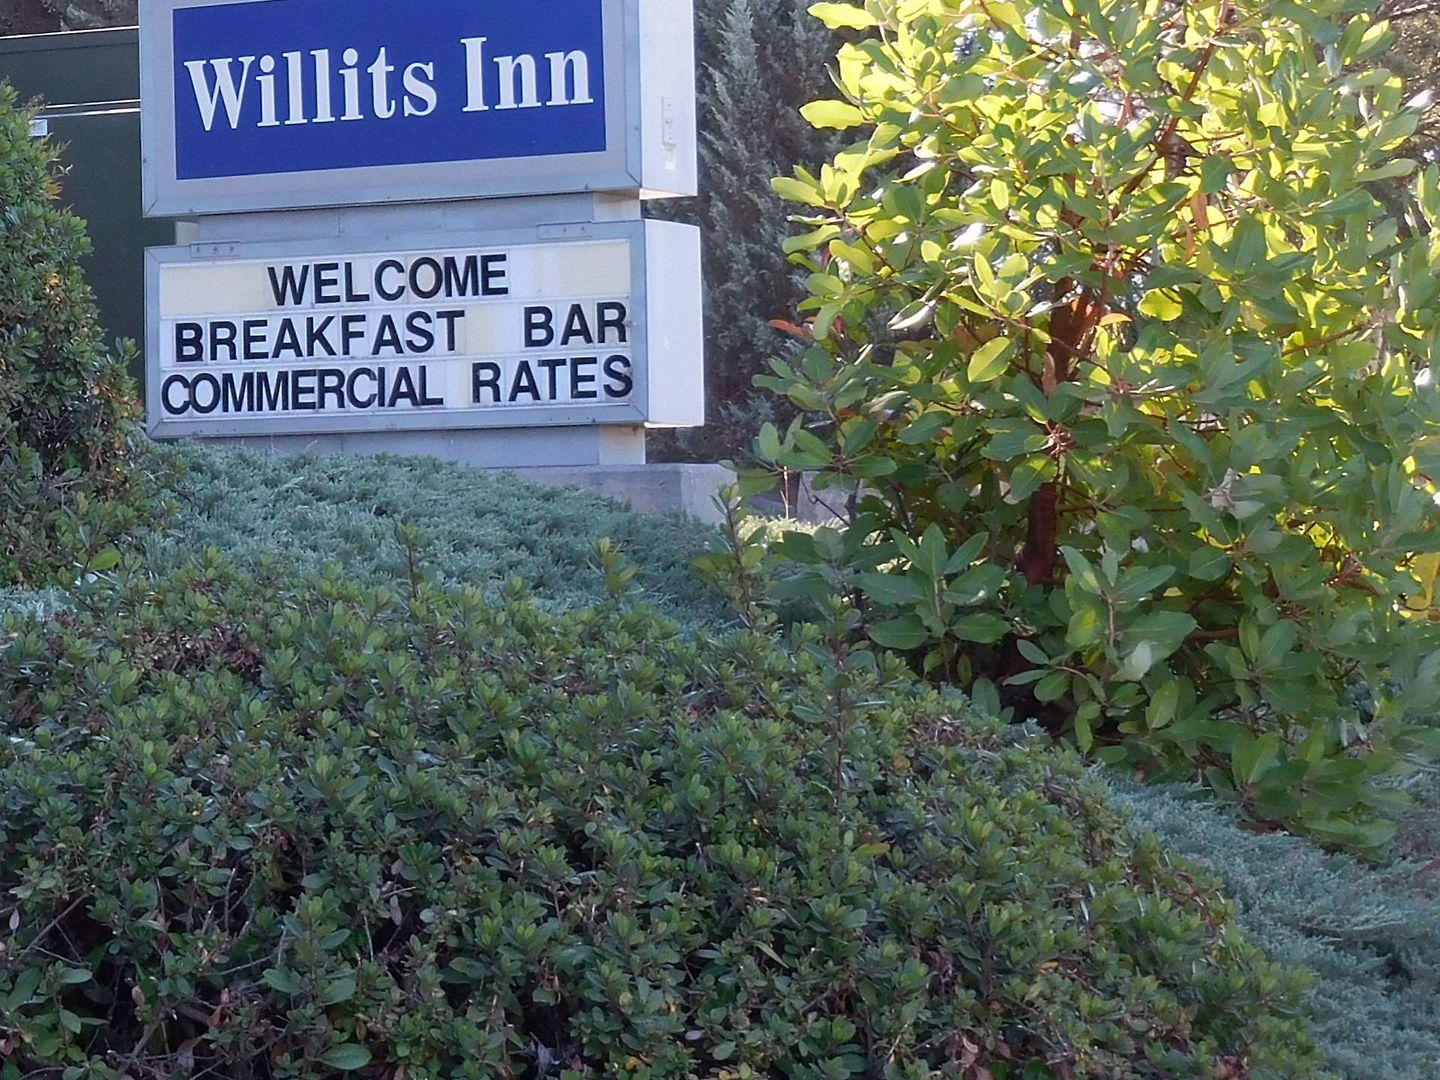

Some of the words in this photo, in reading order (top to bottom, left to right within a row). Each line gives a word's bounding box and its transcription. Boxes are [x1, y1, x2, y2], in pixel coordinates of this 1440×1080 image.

[184, 45, 437, 133] Willits
[460, 36, 593, 112] Inn
[268, 254, 509, 307] WELCOME
[175, 310, 465, 363] BREAKFAST
[525, 302, 628, 348] BAR
[161, 365, 444, 416] COMMERCIAL
[472, 354, 633, 404] RATES
